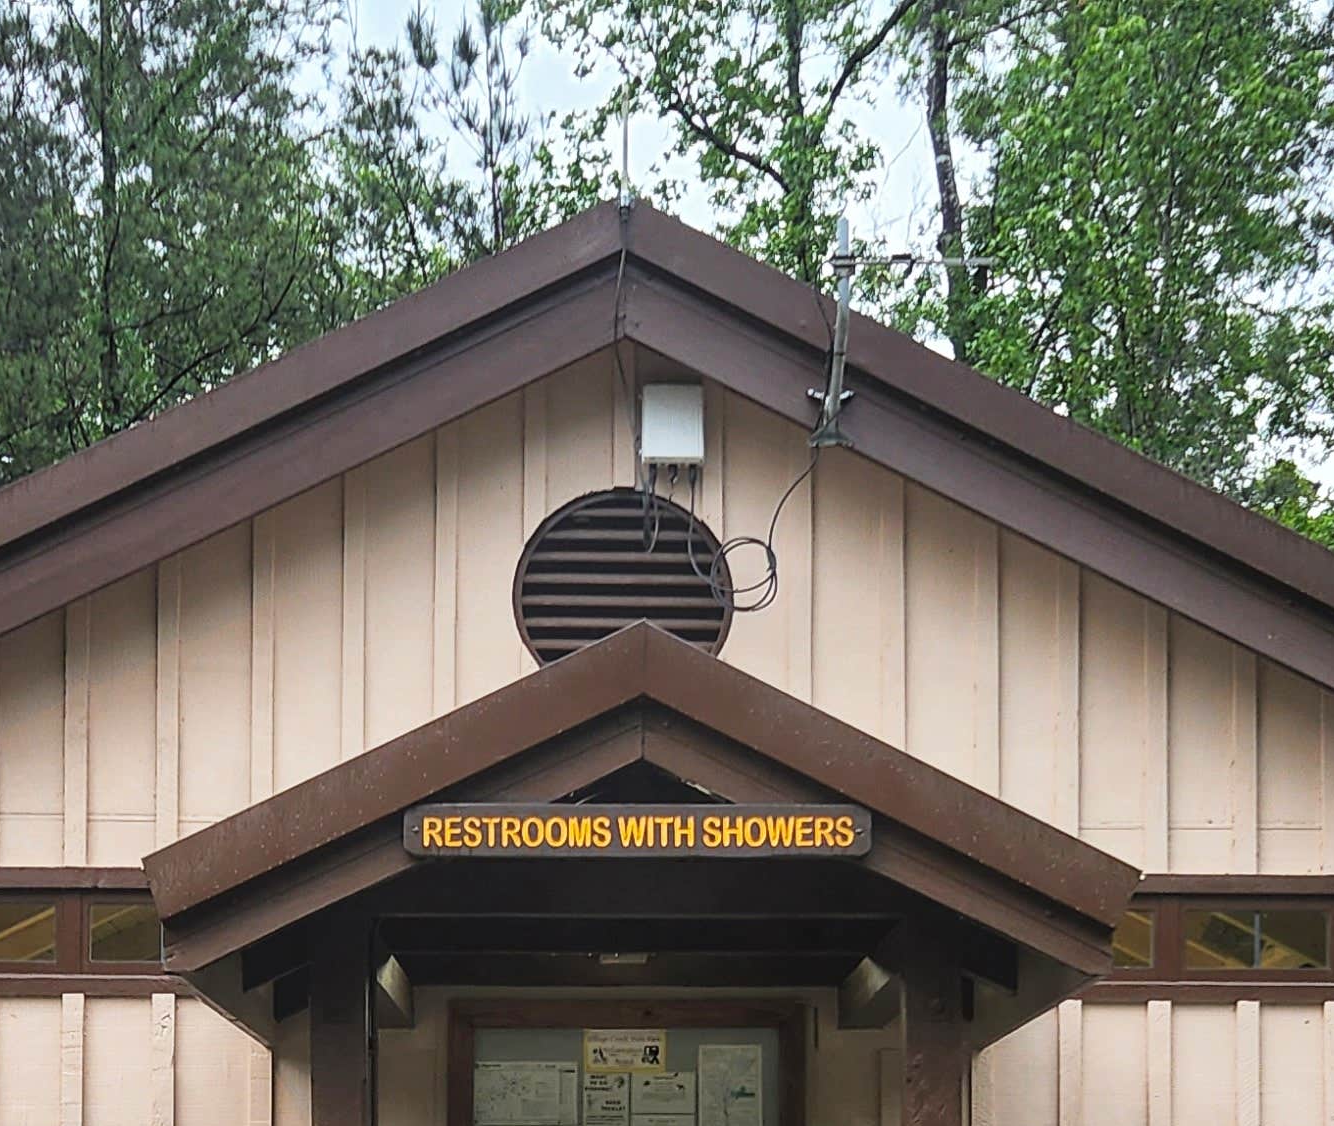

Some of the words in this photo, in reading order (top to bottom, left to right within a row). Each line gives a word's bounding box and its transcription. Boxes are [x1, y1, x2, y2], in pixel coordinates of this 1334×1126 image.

[422, 816, 612, 848] RESTROOMS
[617, 816, 694, 848] WITH
[702, 816, 855, 848] SHOWERS
